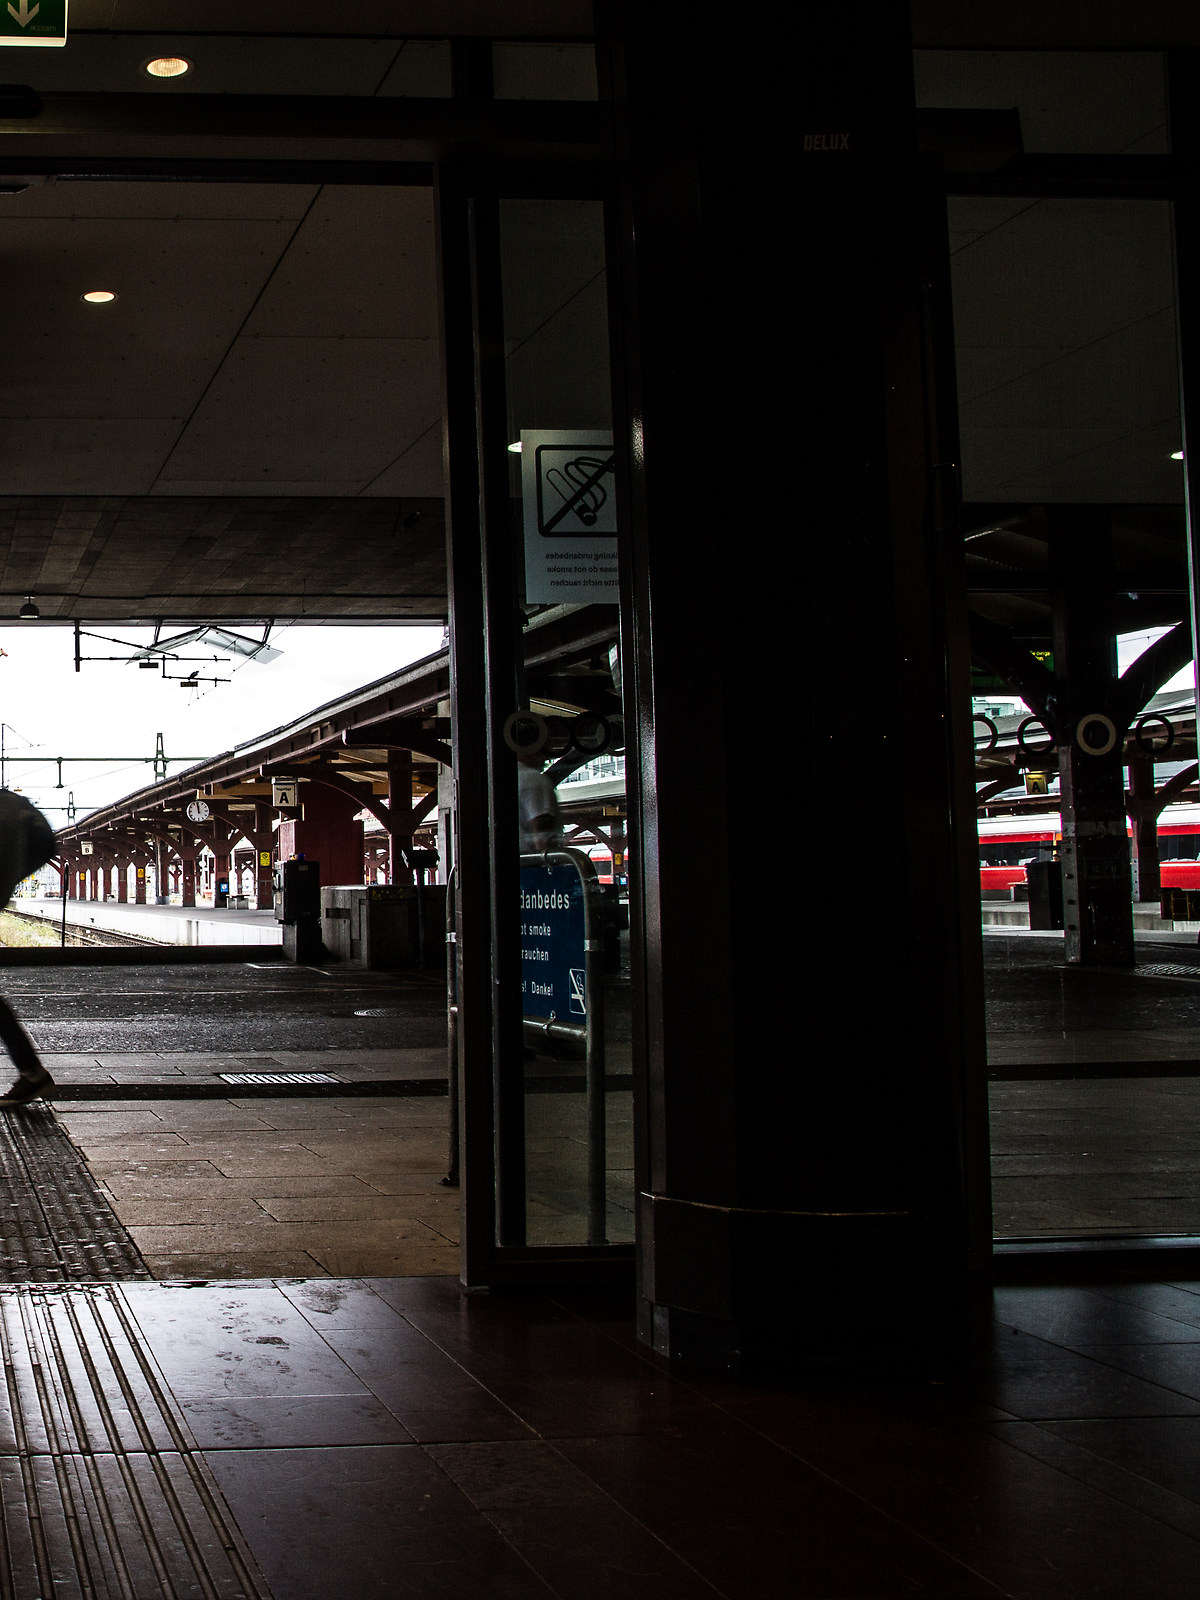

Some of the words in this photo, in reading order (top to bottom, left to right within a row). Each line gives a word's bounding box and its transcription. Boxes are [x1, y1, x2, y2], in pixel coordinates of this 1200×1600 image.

[803, 133, 851, 151] DELUX
[1031, 781, 1042, 793] A
[279, 791, 290, 804] A
[528, 922, 552, 937] smoke
[521, 947, 550, 962] rauchen
[531, 980, 554, 997] Danke!
